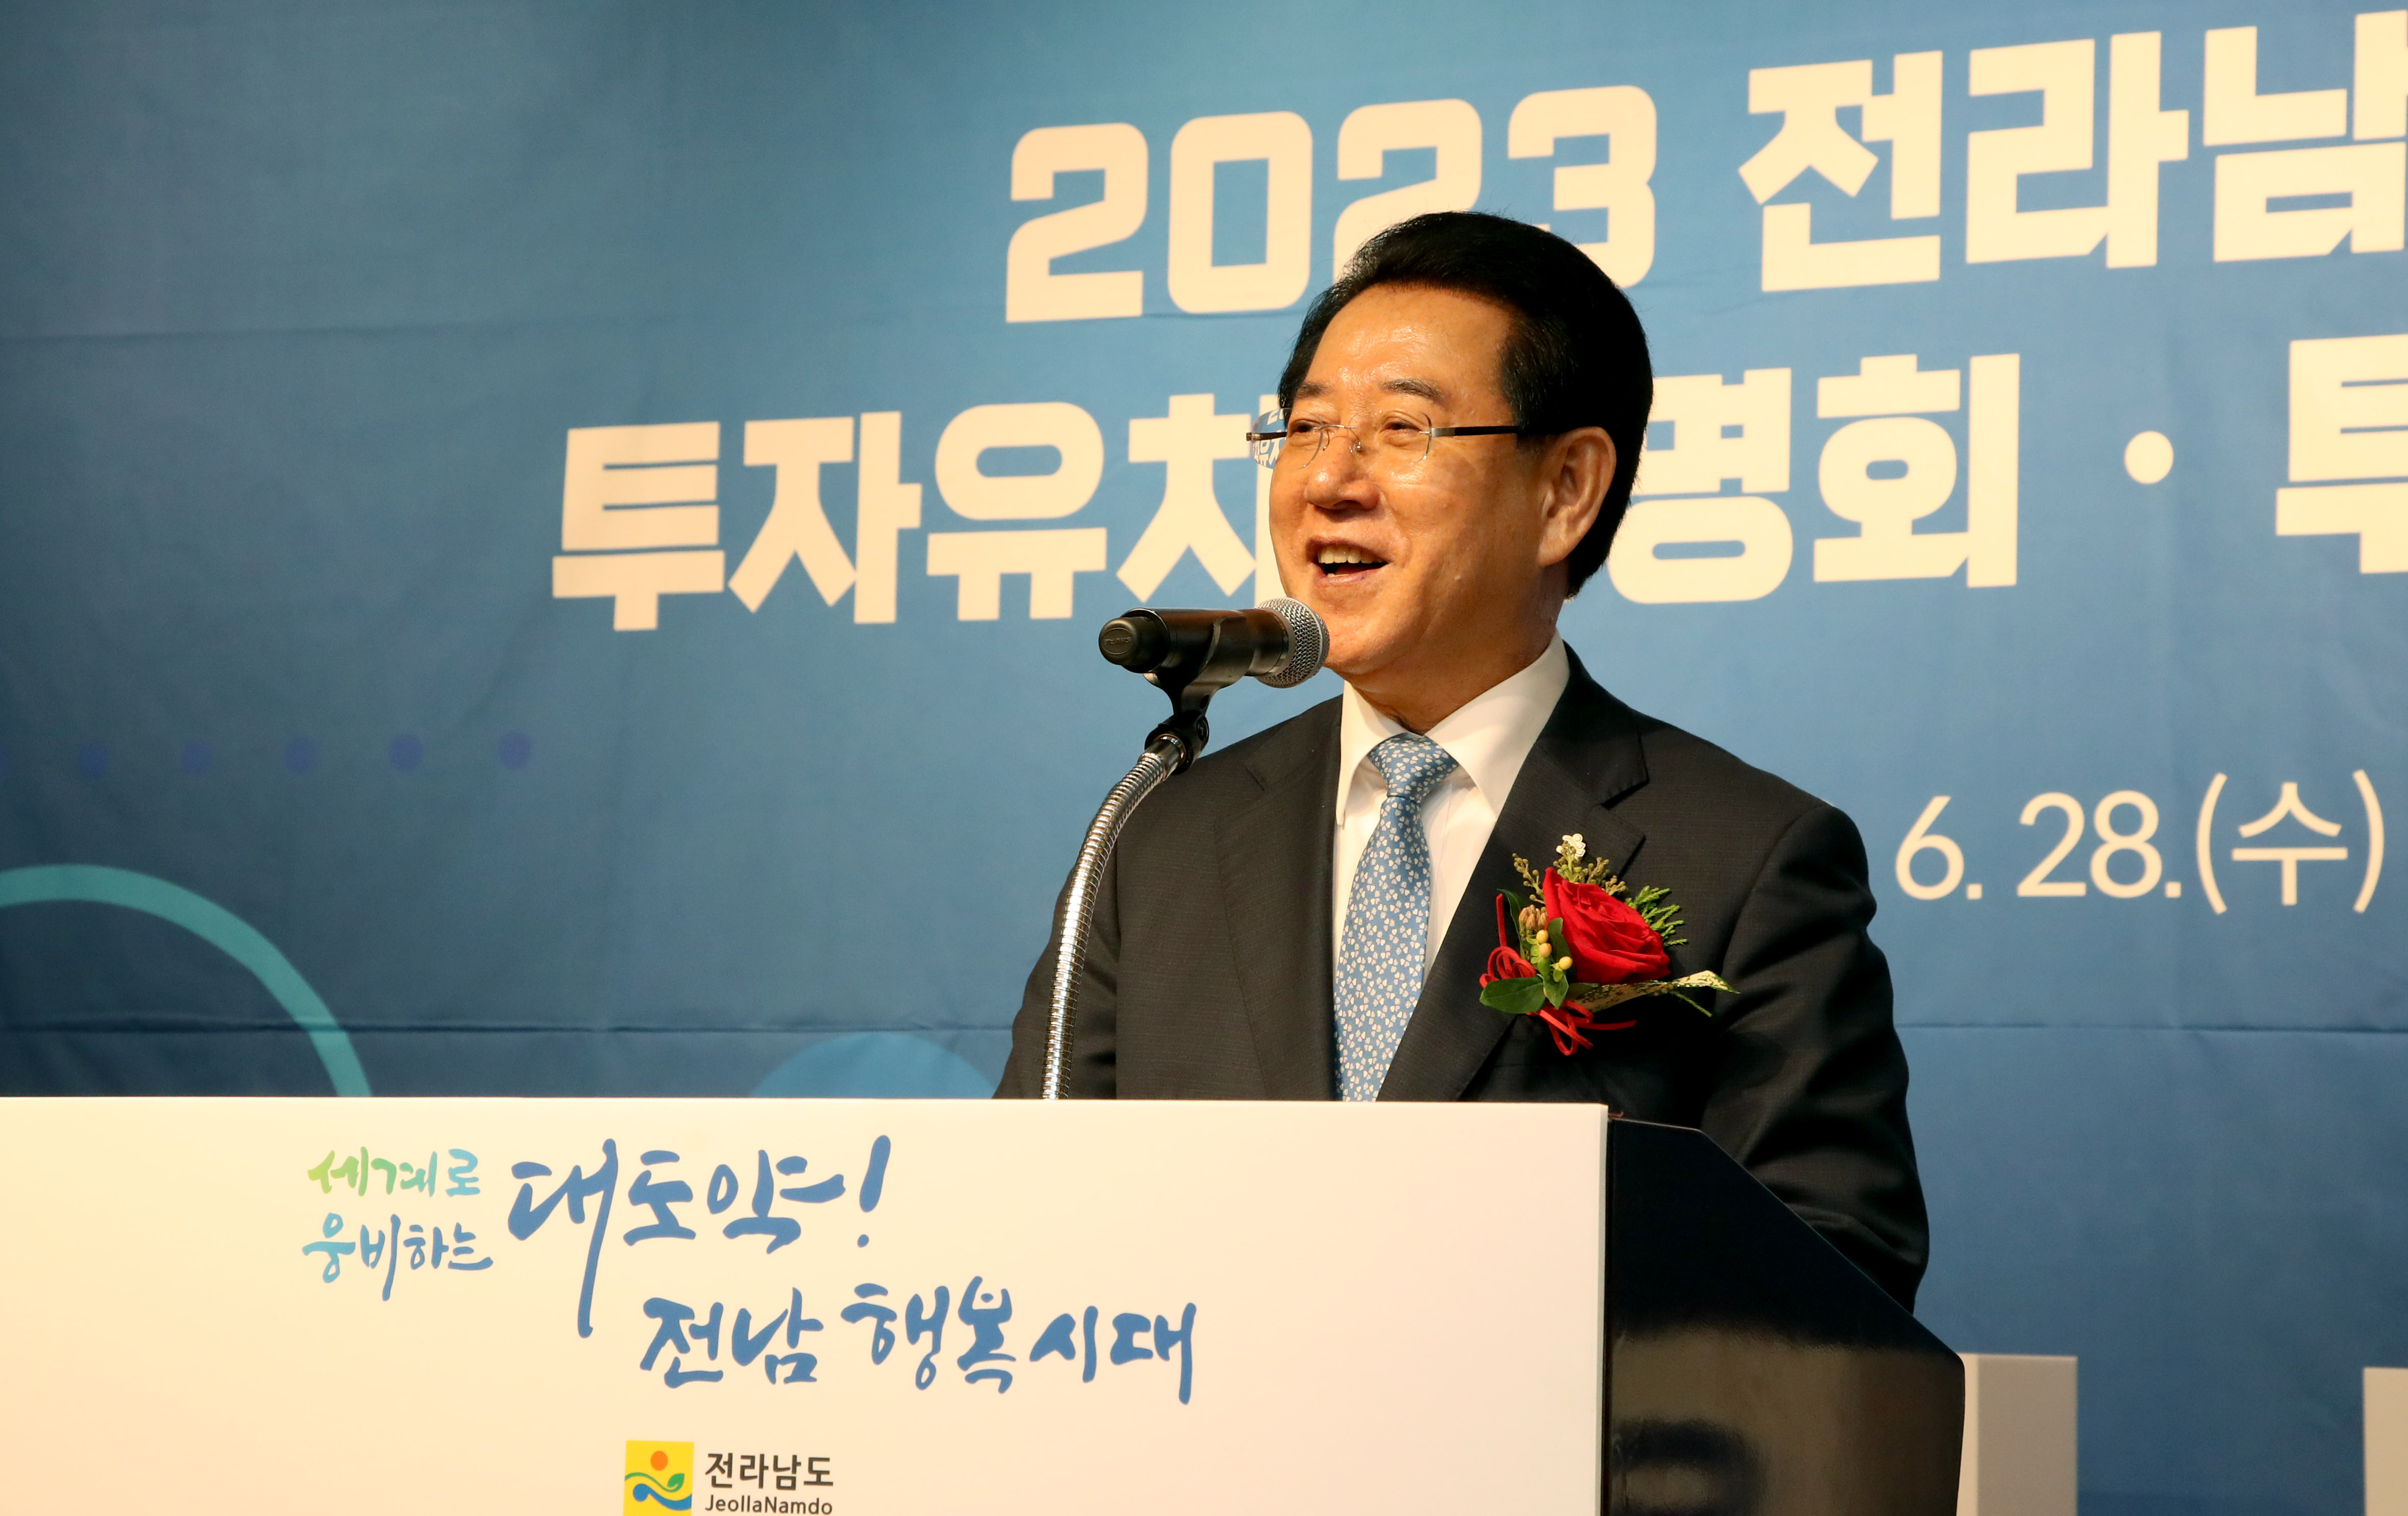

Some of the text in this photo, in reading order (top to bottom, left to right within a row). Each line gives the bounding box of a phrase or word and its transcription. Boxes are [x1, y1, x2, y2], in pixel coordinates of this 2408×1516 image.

[1006, 10, 2408, 322] 2023 전라남
[553, 394, 1288, 630] 투자유치
[1607, 353, 2020, 604] 명회
[1895, 795, 1982, 900] 6.
[308, 1146, 480, 1197] 세계로
[302, 1212, 493, 1301] 웅비하는
[509, 1136, 890, 1337] 대도약!
[641, 1287, 824, 1388] 전남
[705, 1453, 833, 1491] 전라남도
[705, 1495, 832, 1514] JeollaNamdo
